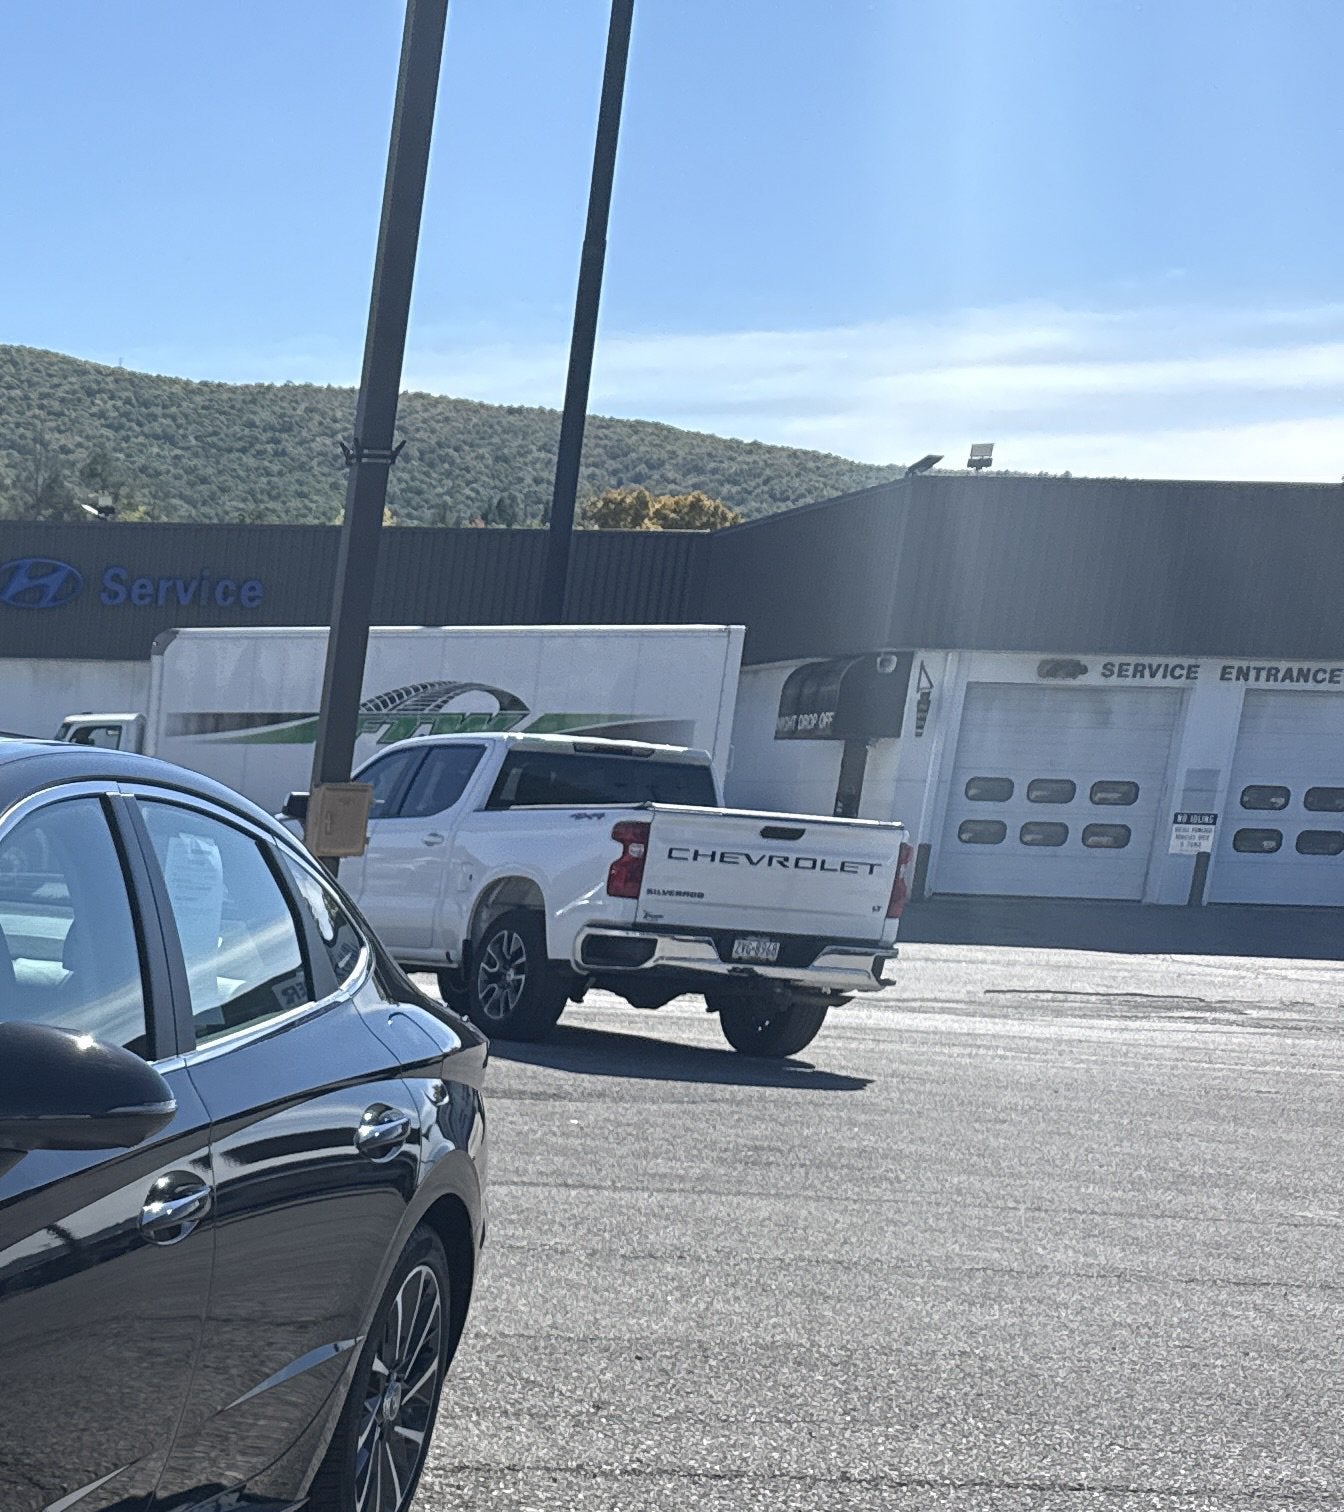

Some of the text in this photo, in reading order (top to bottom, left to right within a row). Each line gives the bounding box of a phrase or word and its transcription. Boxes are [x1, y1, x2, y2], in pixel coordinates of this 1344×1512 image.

[100, 566, 263, 608] Service
[1100, 662, 1344, 685] SERVICE ENTRANCE
[667, 847, 883, 875] CHEVROLET
